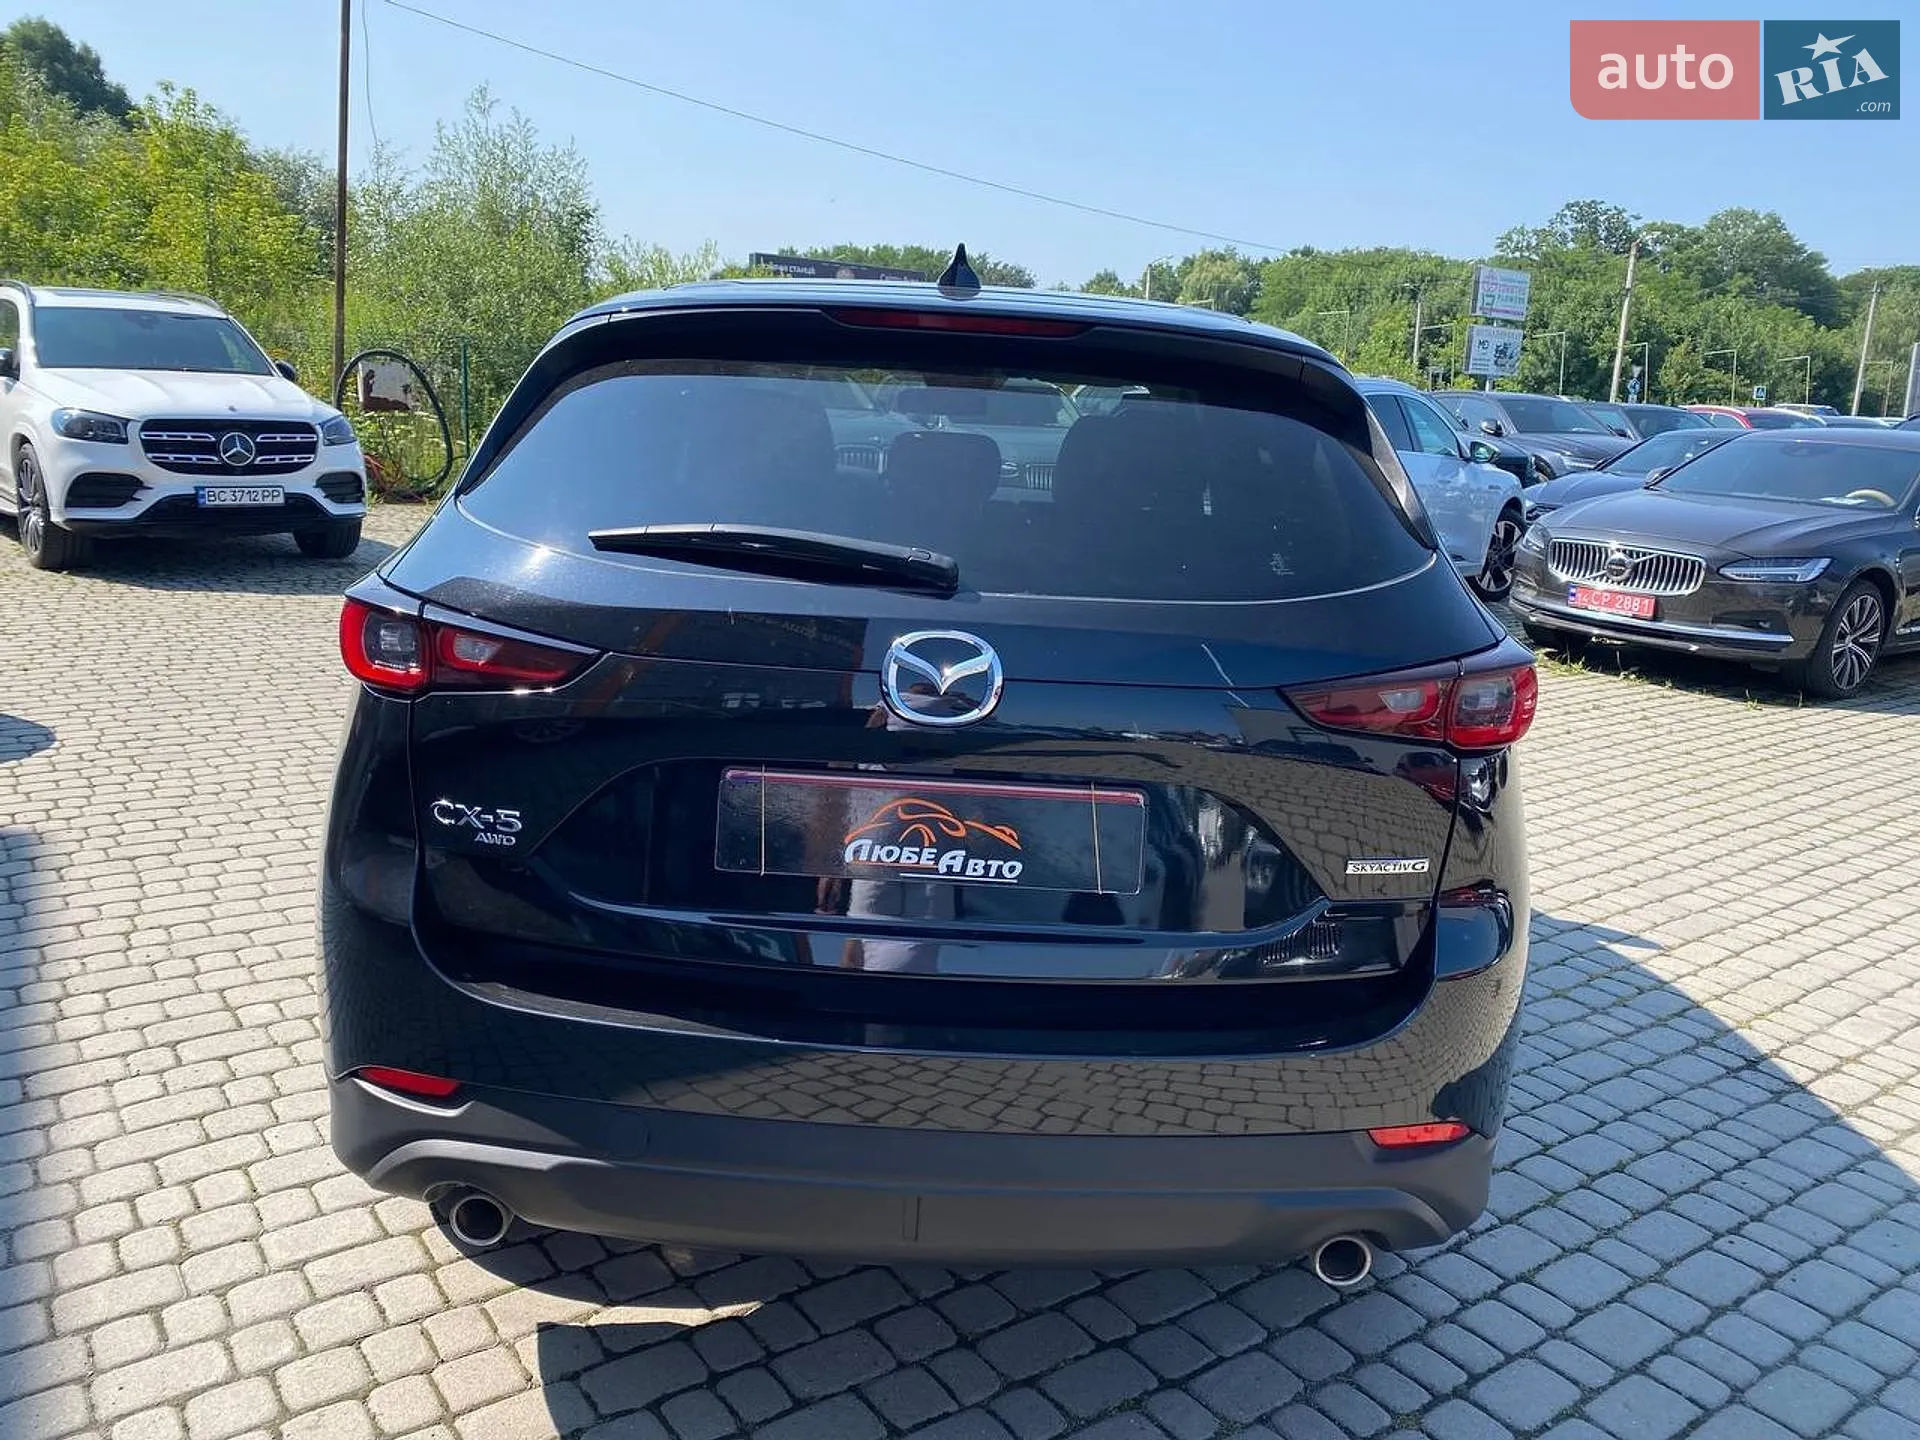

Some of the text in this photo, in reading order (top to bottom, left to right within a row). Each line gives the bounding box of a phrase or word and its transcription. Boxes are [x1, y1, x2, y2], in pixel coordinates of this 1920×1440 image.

[207, 489, 281, 503] BC 3712 PP
[431, 799, 522, 833] CX-5
[474, 832, 516, 846] AWD
